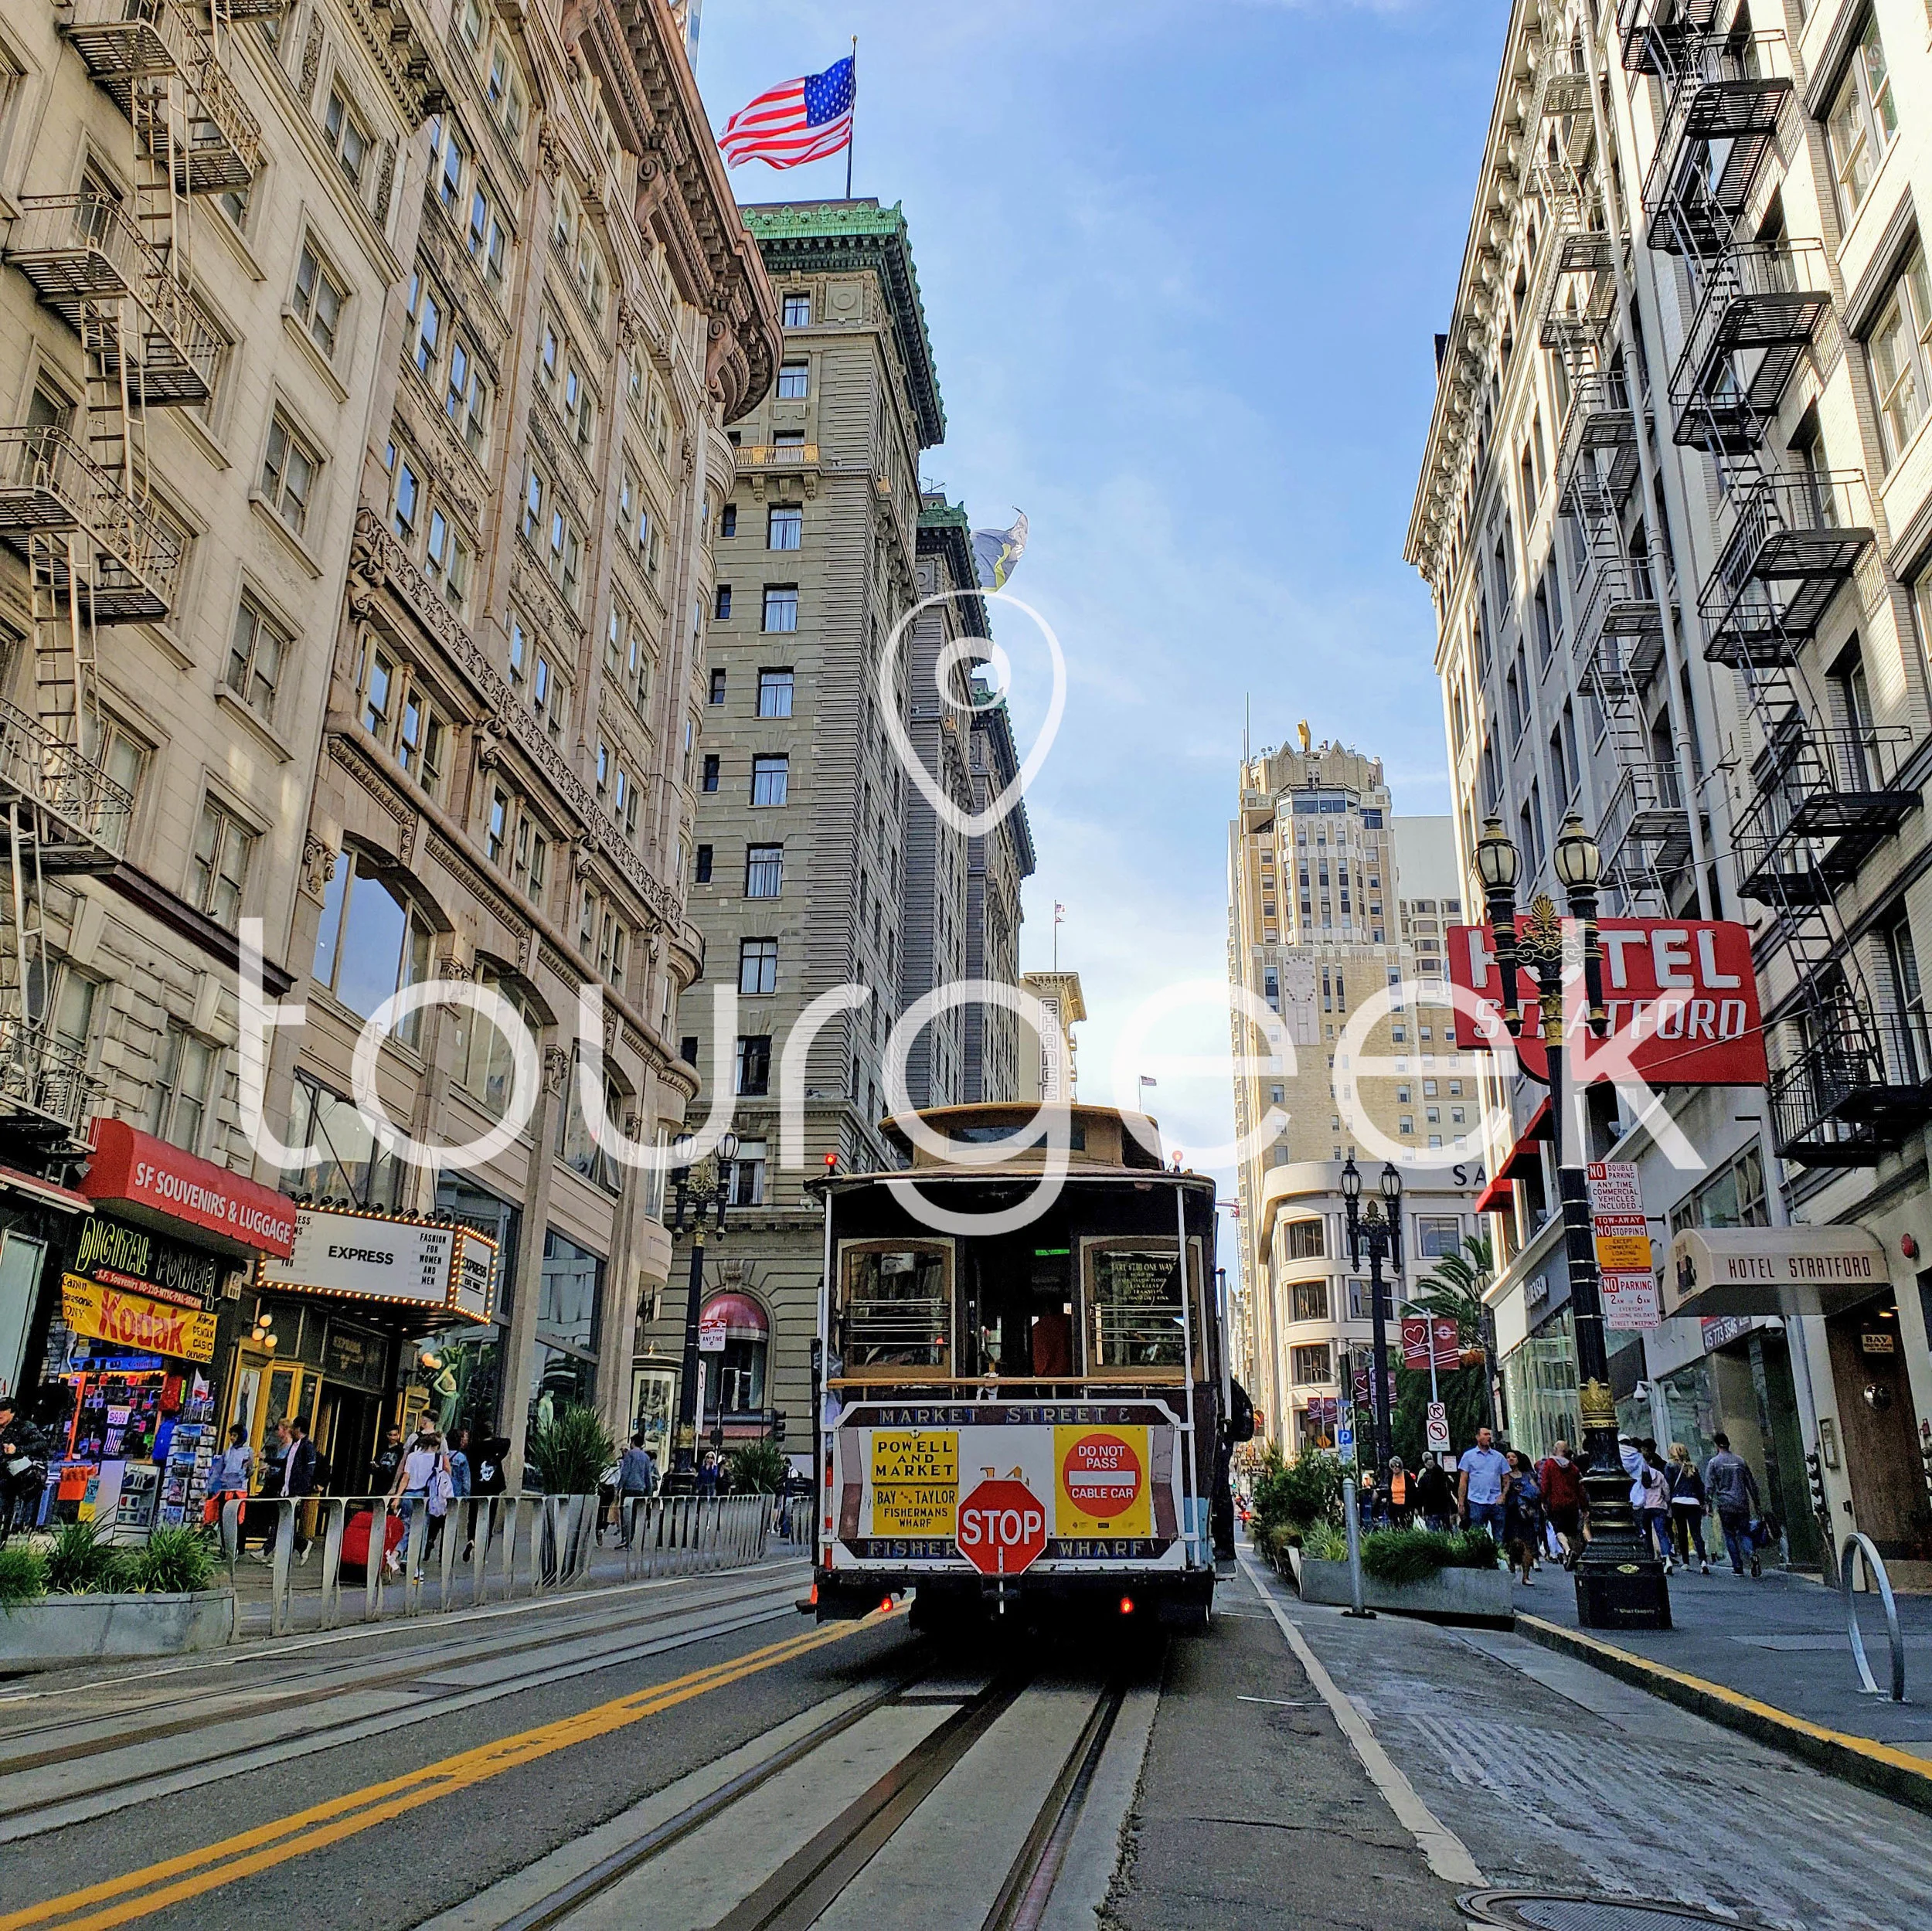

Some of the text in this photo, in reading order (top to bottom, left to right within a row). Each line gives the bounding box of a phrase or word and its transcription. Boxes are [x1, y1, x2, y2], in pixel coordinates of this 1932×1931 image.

[1589, 1164, 1604, 1178] NO
[134, 1162, 291, 1245] SF SOUVENIRS & LUGGAGE
[1597, 1225, 1611, 1236] NO
[420, 1232, 447, 1244] FASHION
[75, 1217, 149, 1276] DIGITAL
[427, 1245, 438, 1255] FOR
[328, 1245, 394, 1265] EXPRESS
[419, 1255, 441, 1265] WOMEN
[423, 1266, 436, 1275] AND
[1728, 1256, 1871, 1278] HOTEL STRATFORD
[421, 1276, 435, 1286] MEN
[1604, 1278, 1652, 1292] NO PARKING
[98, 1289, 185, 1354] Kodak
[192, 1325, 214, 1338] PENTAX
[186, 1350, 213, 1362] OLYMPUS
[879, 1407, 978, 1423] MARKET
[1005, 1406, 1107, 1423] STREET
[878, 1441, 952, 1453] POWELL
[1078, 1446, 1125, 1457] DO NOT
[897, 1454, 934, 1463] AND
[1086, 1457, 1117, 1468] PASS
[876, 1464, 954, 1477] MARKET
[877, 1491, 896, 1504] BAY
[915, 1491, 955, 1504] TAYLOR
[1071, 1487, 1134, 1499] CABLE CAR
[884, 1508, 947, 1518] FISHERMANS
[899, 1518, 932, 1528] WHARF
[962, 1509, 1042, 1545] STOP
[1056, 1541, 1145, 1558] WHARF
